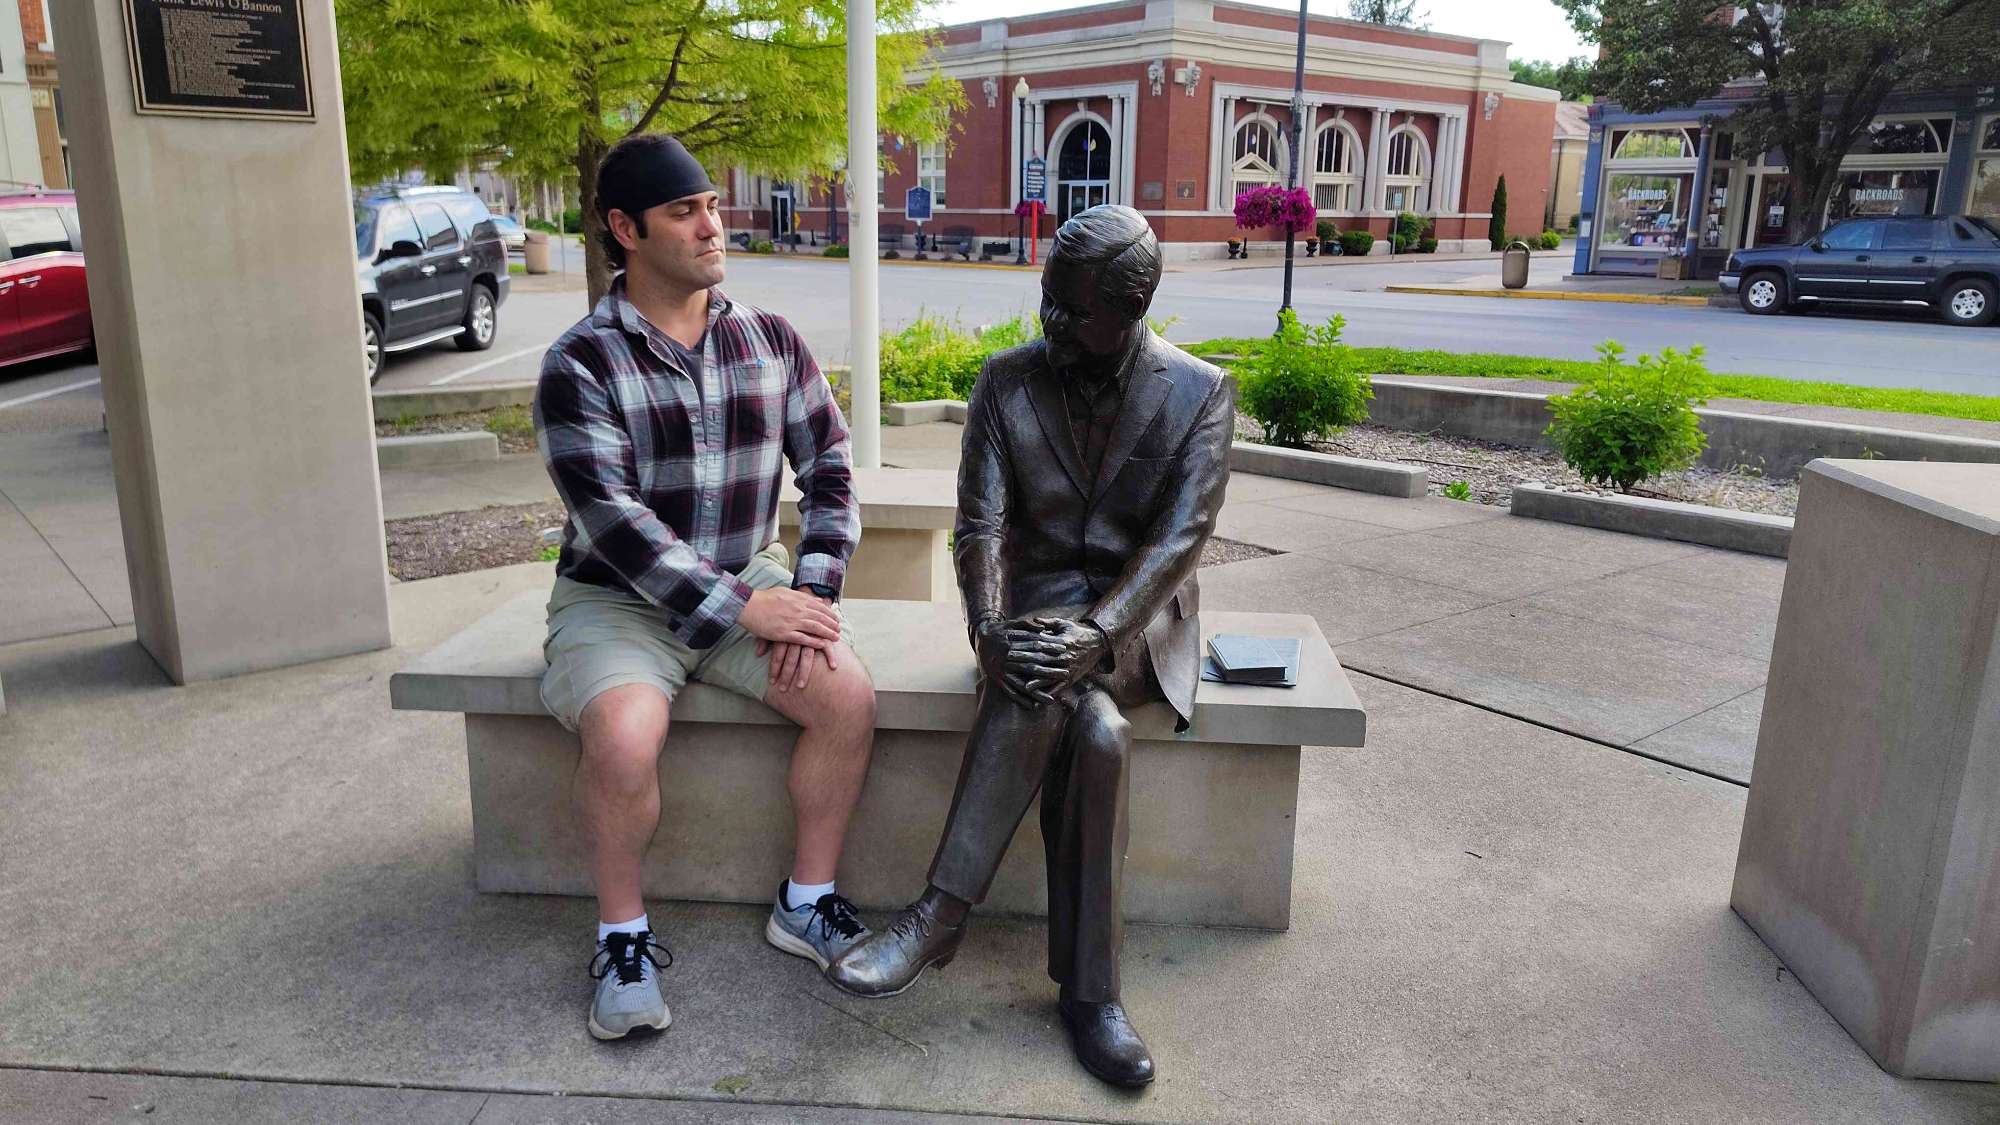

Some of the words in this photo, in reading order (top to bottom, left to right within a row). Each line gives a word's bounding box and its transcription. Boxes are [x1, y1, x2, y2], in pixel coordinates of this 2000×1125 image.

[191, 0, 224, 8] Lewis
[1627, 188, 1667, 201] BACKROADS
[1855, 189, 1904, 201] BACKROADS
